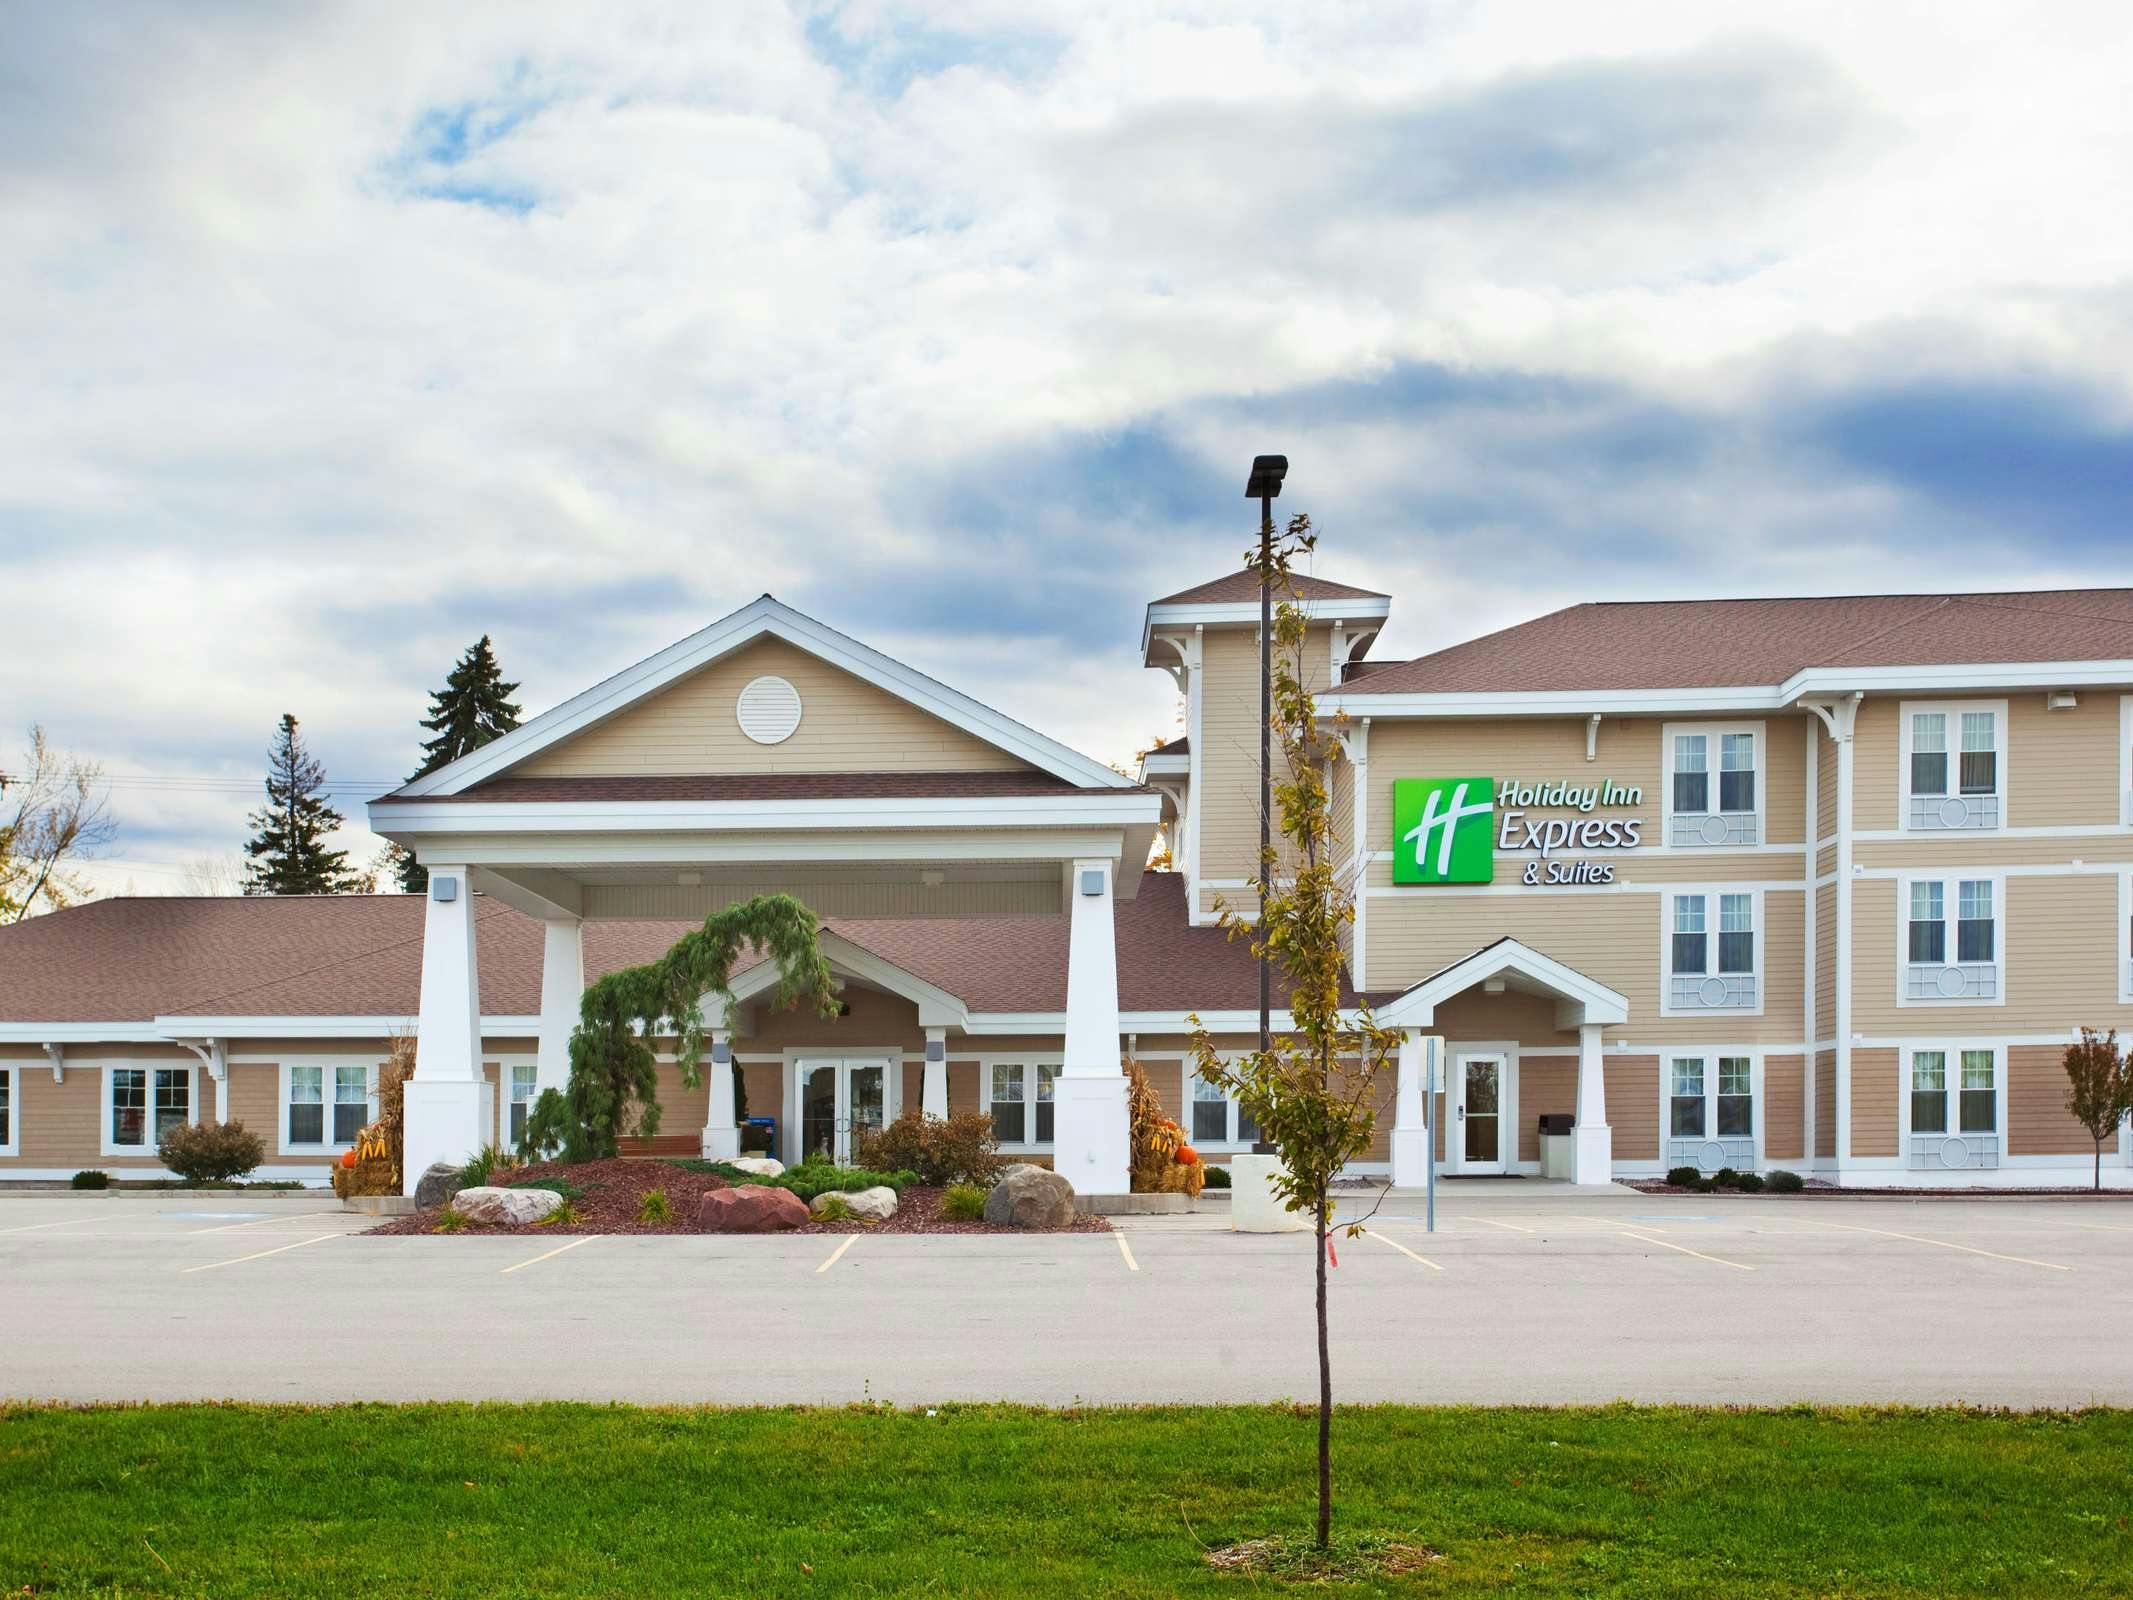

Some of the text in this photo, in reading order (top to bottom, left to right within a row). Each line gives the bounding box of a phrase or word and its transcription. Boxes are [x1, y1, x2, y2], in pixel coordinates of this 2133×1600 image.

[1497, 778, 1643, 812] Holiday Inn
[1403, 783, 1493, 876] H
[1499, 811, 1642, 859] Express
[1523, 860, 1615, 885] & Suites
